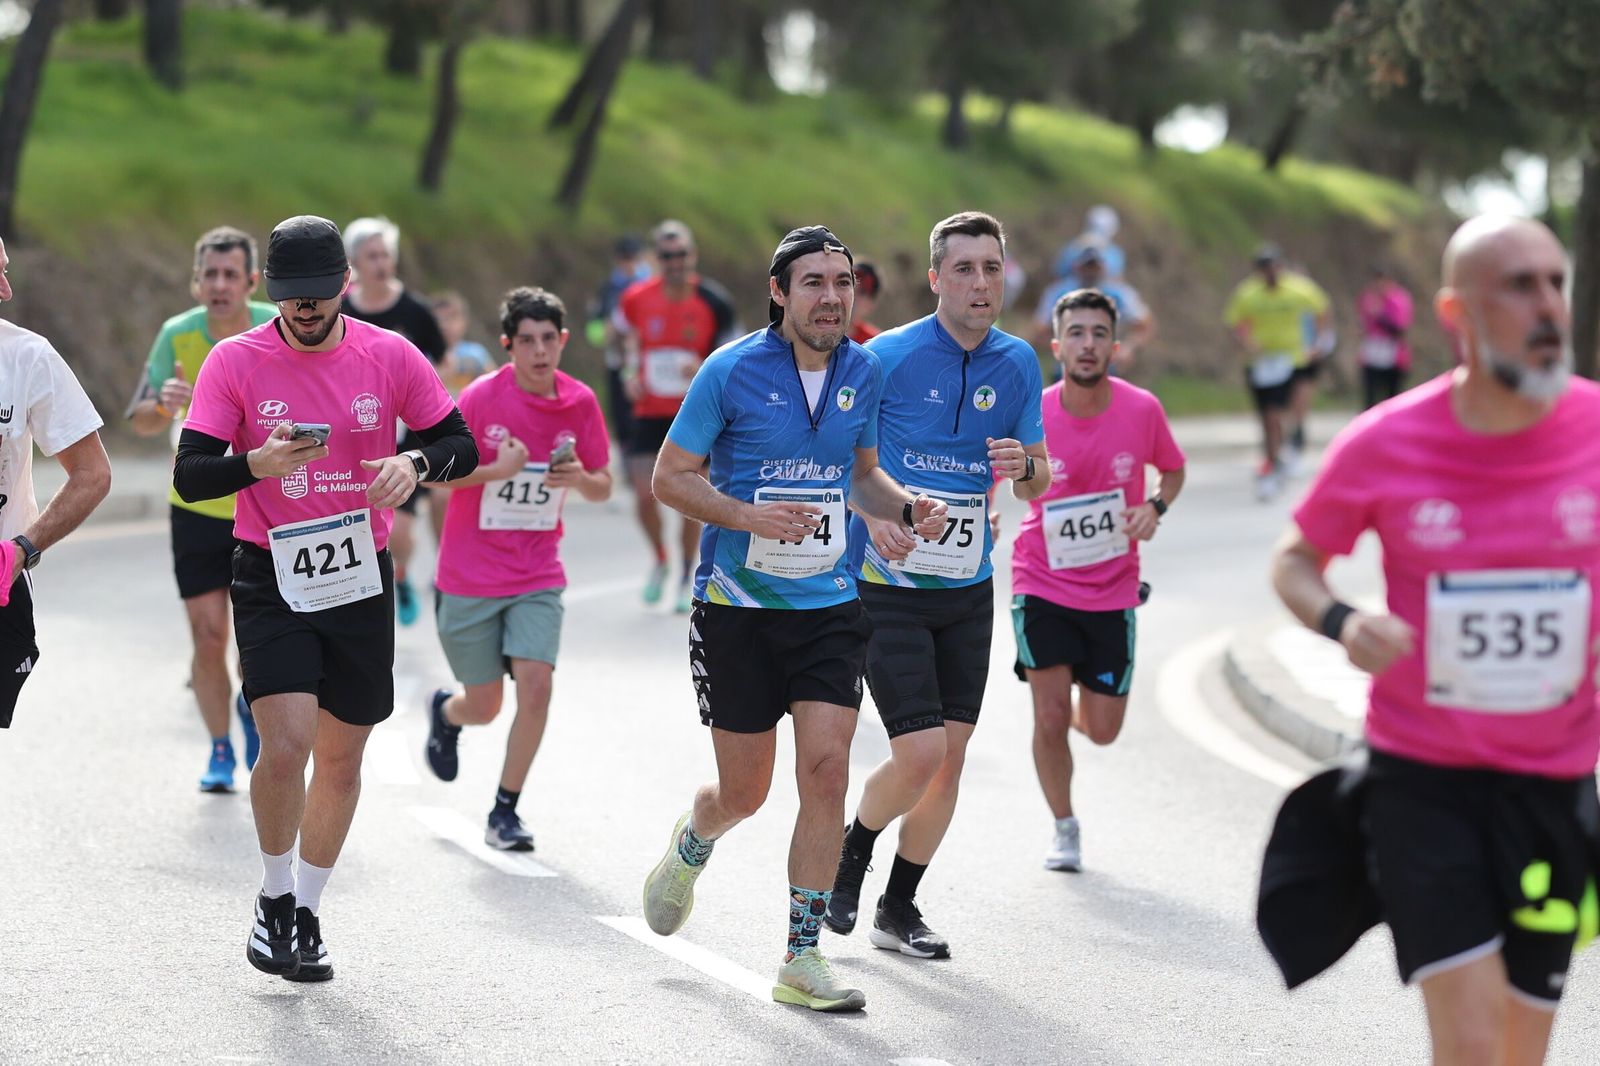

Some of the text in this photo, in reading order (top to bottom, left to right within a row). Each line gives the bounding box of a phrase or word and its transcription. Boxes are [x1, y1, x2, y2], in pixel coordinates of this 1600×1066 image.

[313, 470, 353, 481] Ciudad
[763, 458, 808, 466] DISFRUTA
[314, 481, 368, 493] de Málaga
[497, 480, 551, 505] 415
[913, 517, 974, 548] 75
[1060, 510, 1115, 541] 464
[293, 537, 362, 579] 421
[1460, 611, 1560, 660] 535
